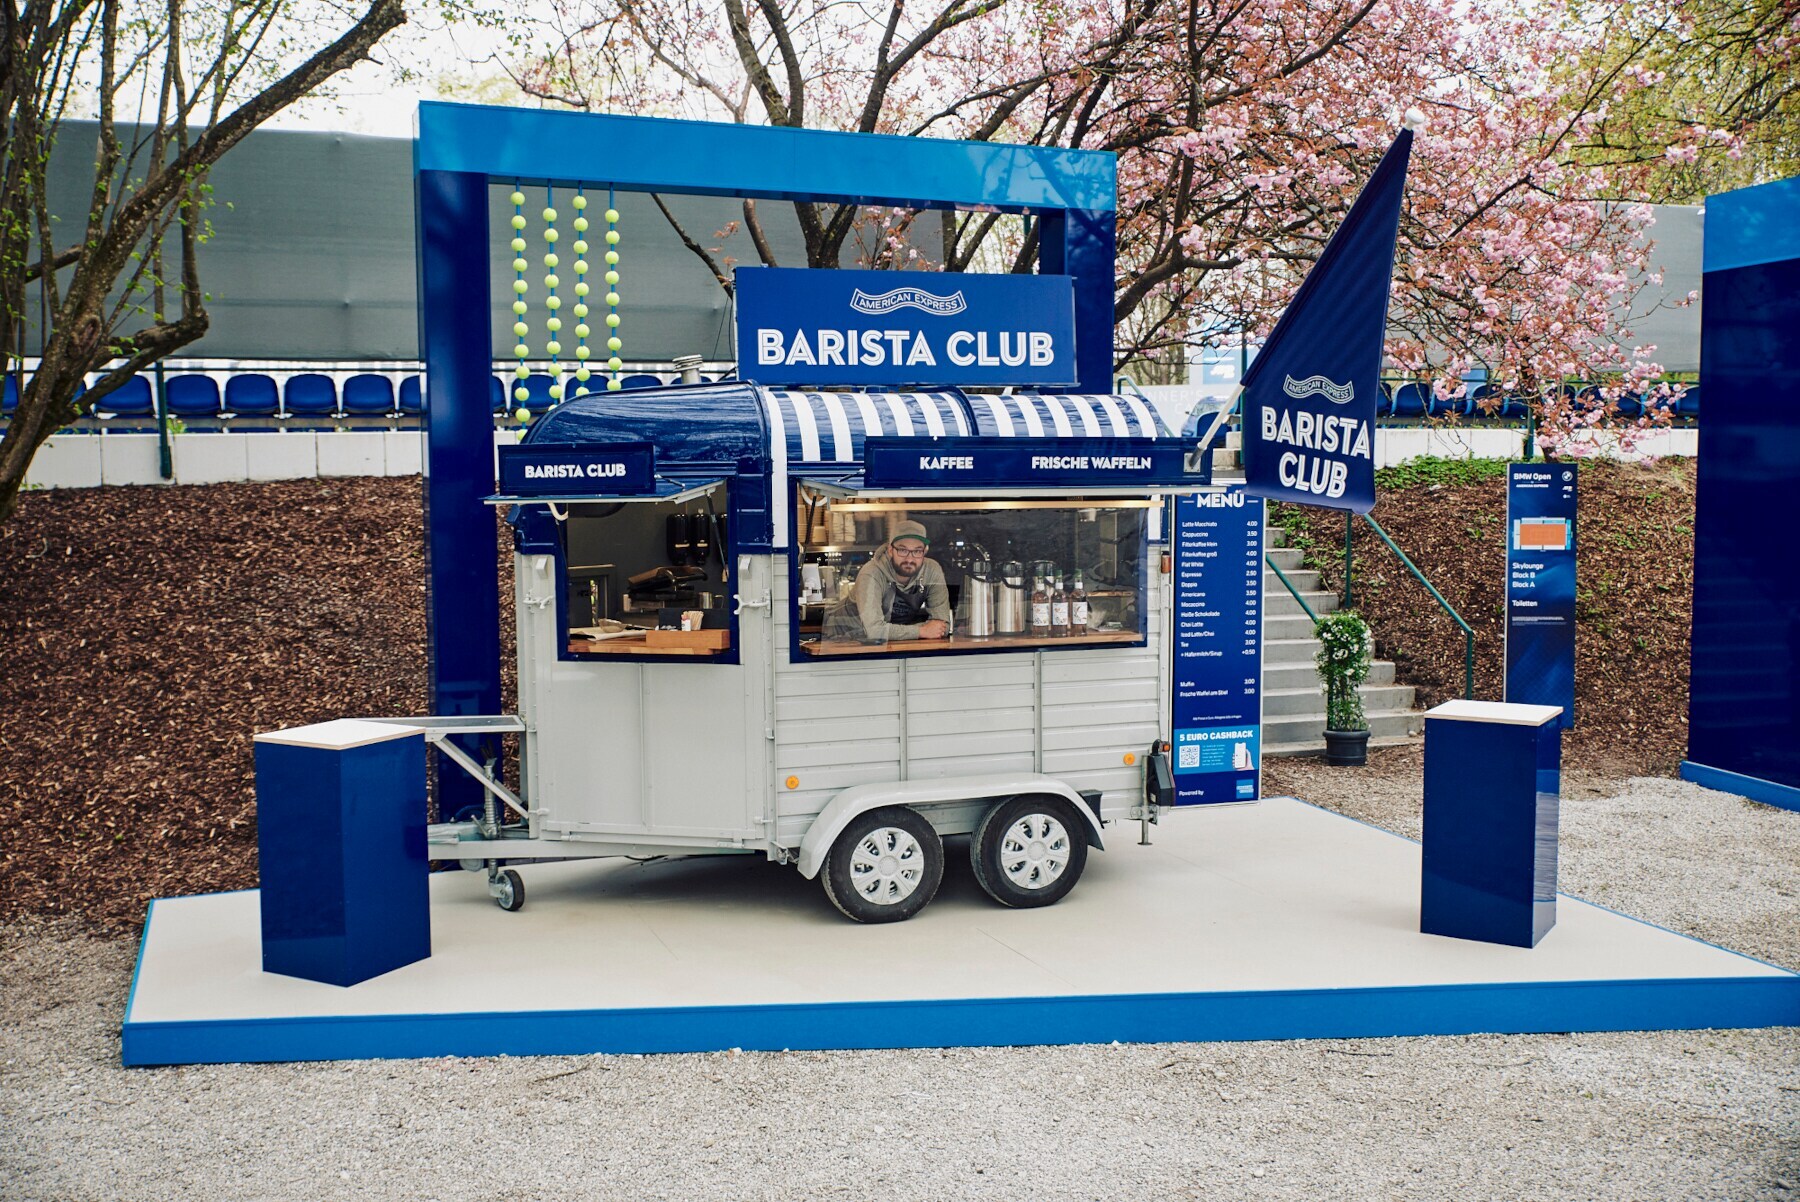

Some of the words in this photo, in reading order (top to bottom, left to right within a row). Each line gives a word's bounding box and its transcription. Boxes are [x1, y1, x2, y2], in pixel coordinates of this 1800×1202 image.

[859, 292, 913, 308] AMERICAN
[914, 294, 959, 310] EXPRESS
[758, 329, 936, 366] BARISTA
[947, 331, 1054, 366] CLUB
[1289, 380, 1321, 393] AMERICAN
[1322, 383, 1349, 399] EXPRESS
[1261, 405, 1371, 459] BARISTA
[920, 457, 973, 469] KAFFEE
[1032, 456, 1088, 469] FRISCHE
[1091, 457, 1151, 469] WAFFELN
[525, 465, 584, 478] BARISTA
[587, 463, 626, 477] CLUB
[1279, 452, 1348, 498] CLUB
[1533, 473, 1551, 481] Open
[1197, 490, 1245, 508] MENÜ
[1512, 562, 1544, 570] Skylounge
[1512, 571, 1529, 579] Block
[1179, 733, 1185, 741] 5
[1186, 733, 1208, 741] EURO
[1210, 730, 1253, 740] CASHBACK
